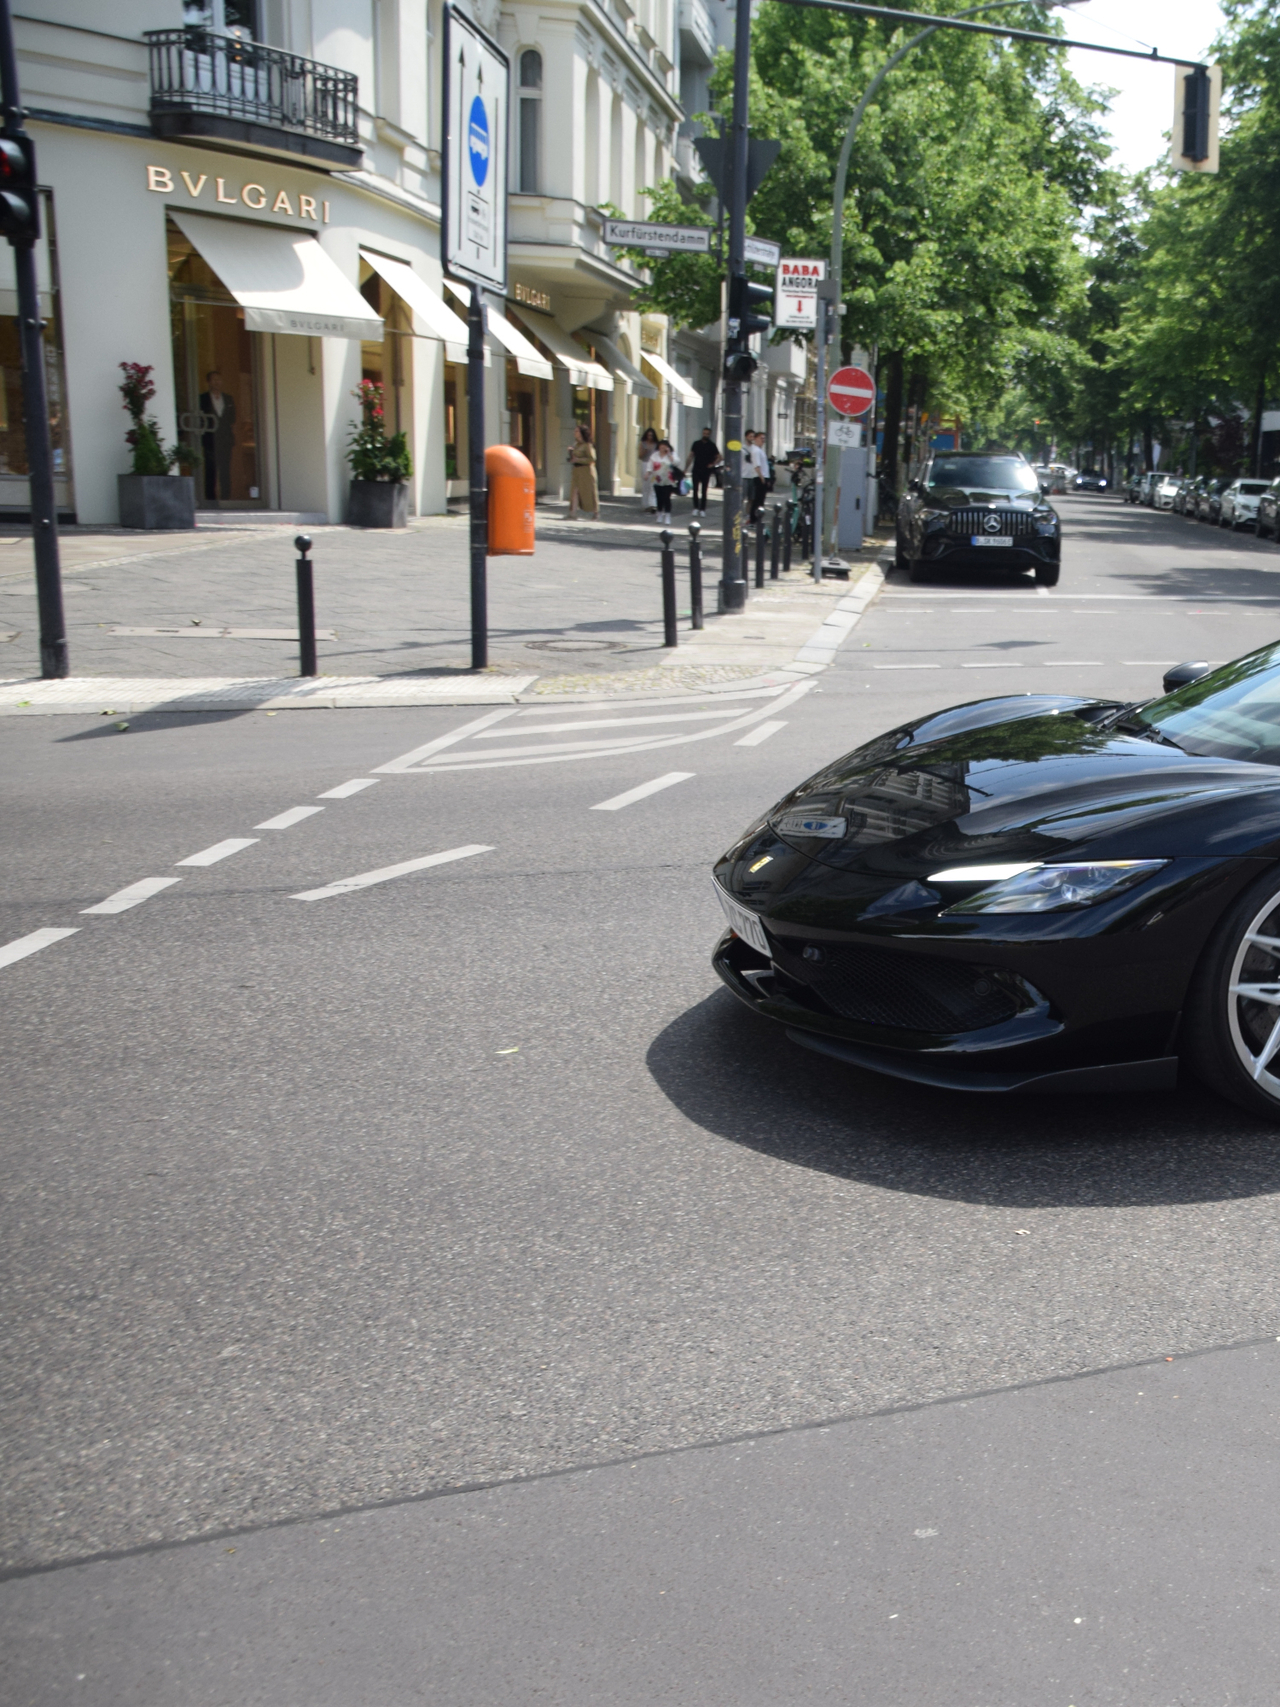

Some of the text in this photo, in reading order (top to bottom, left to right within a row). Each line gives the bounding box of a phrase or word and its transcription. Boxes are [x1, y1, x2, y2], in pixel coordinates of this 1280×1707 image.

[146, 165, 331, 224] BVLGARI
[609, 224, 707, 245] Kurfürstendamm
[782, 264, 820, 276] BABA
[290, 320, 344, 332] BVLGARI
